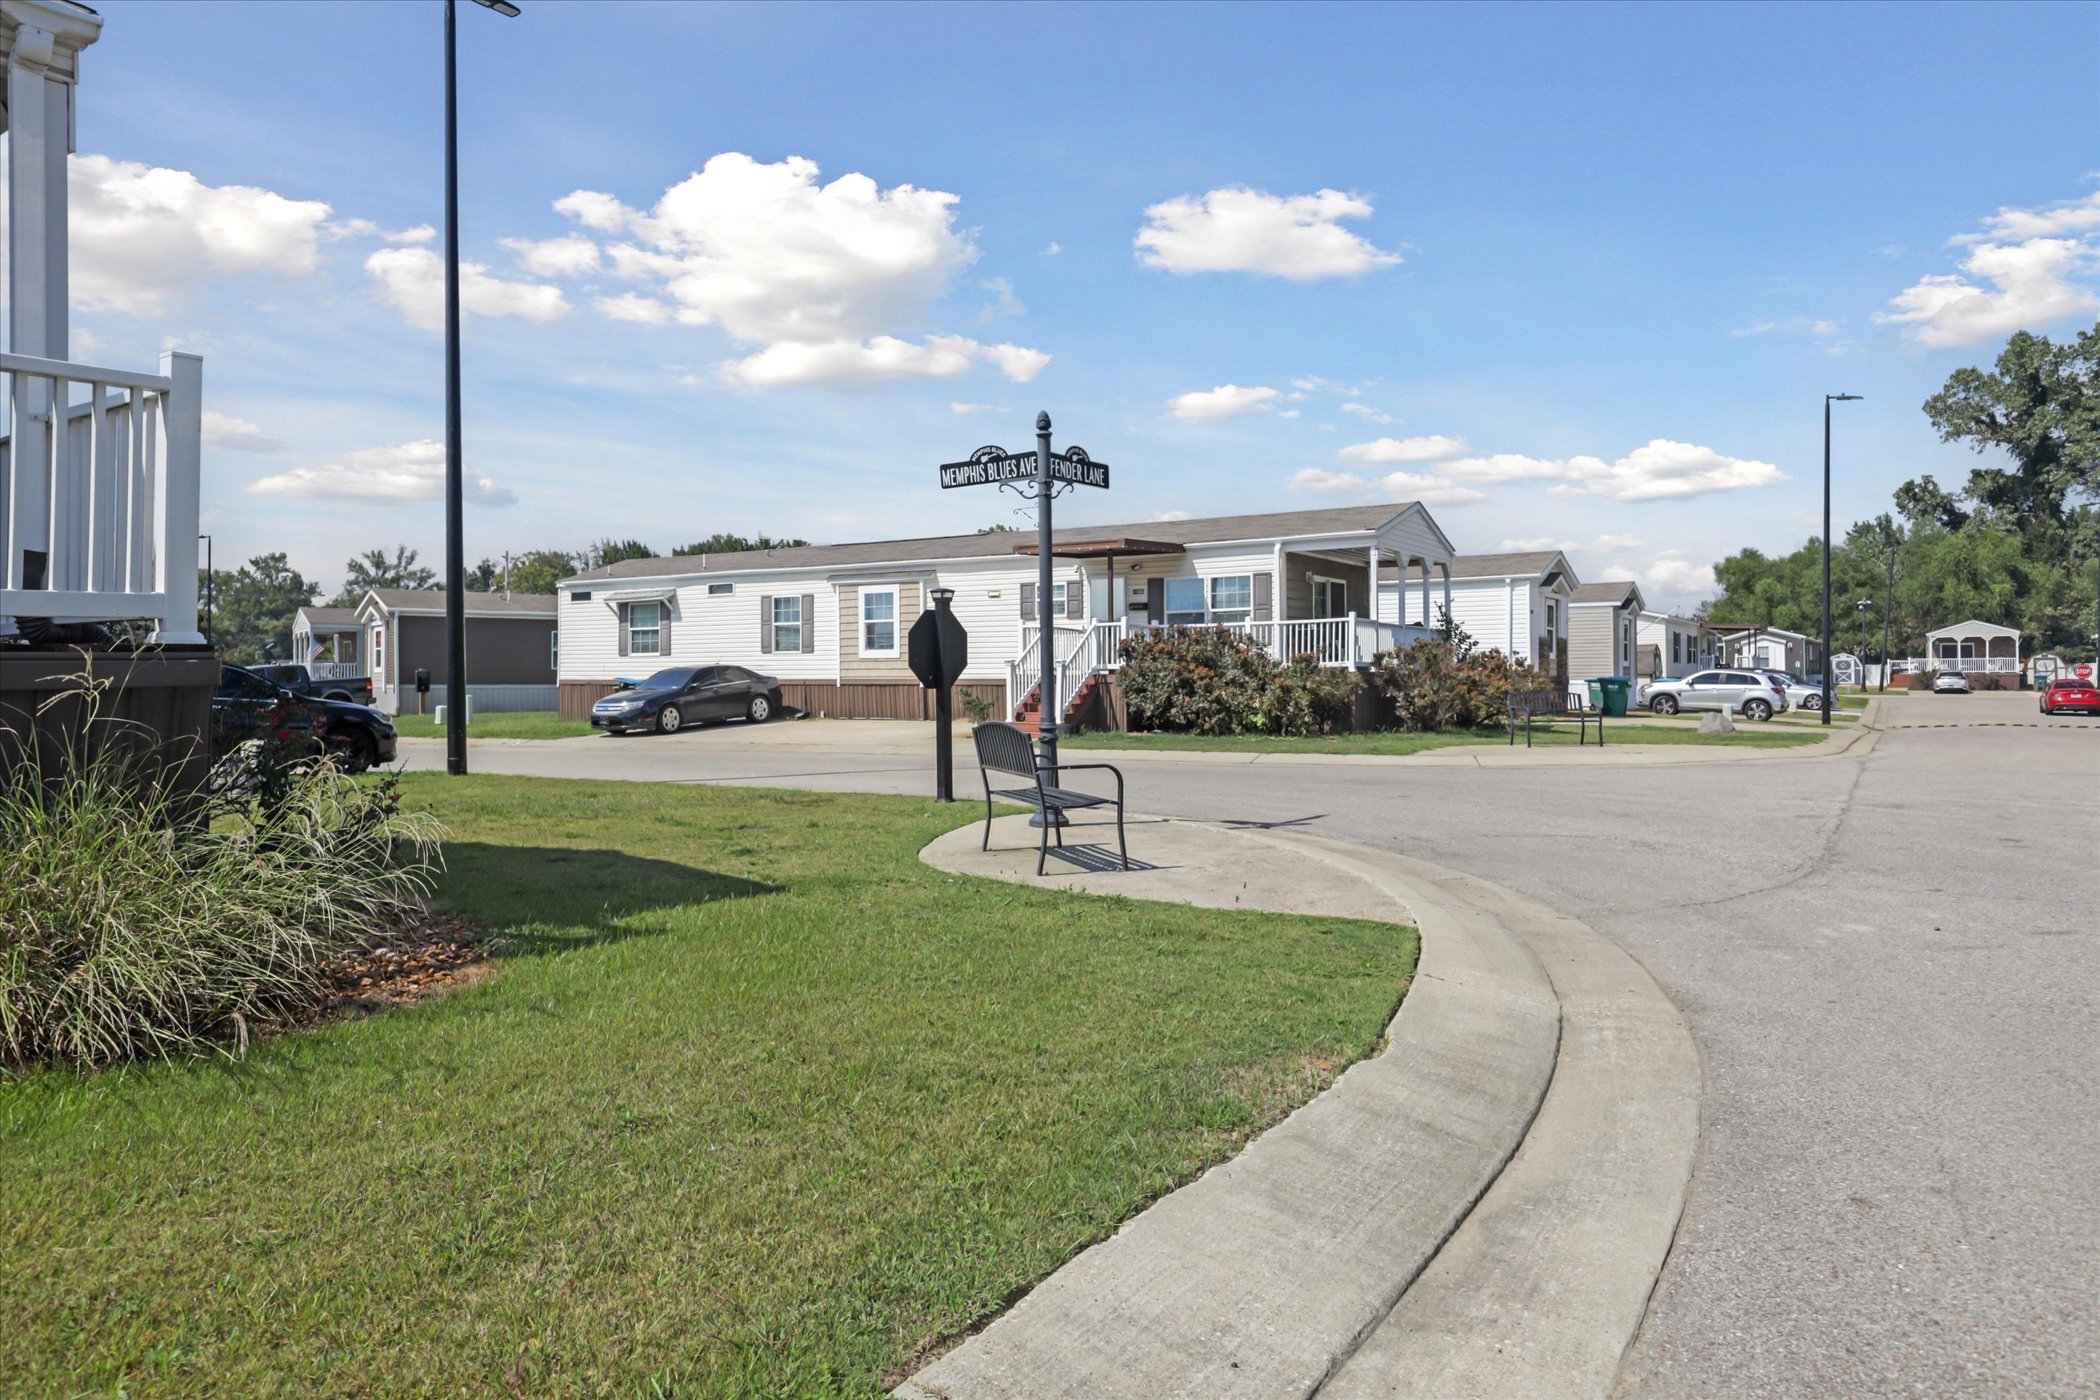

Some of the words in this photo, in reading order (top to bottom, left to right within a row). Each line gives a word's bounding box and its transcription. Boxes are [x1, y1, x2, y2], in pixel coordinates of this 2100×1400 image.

[971, 447, 991, 462] MEMPHIS
[941, 463, 986, 487] MEMPHIS
[987, 459, 1017, 481] BLUES
[1019, 456, 1038, 476] AVE
[1050, 458, 1083, 482] FENDER
[1084, 465, 1105, 486] LANE
